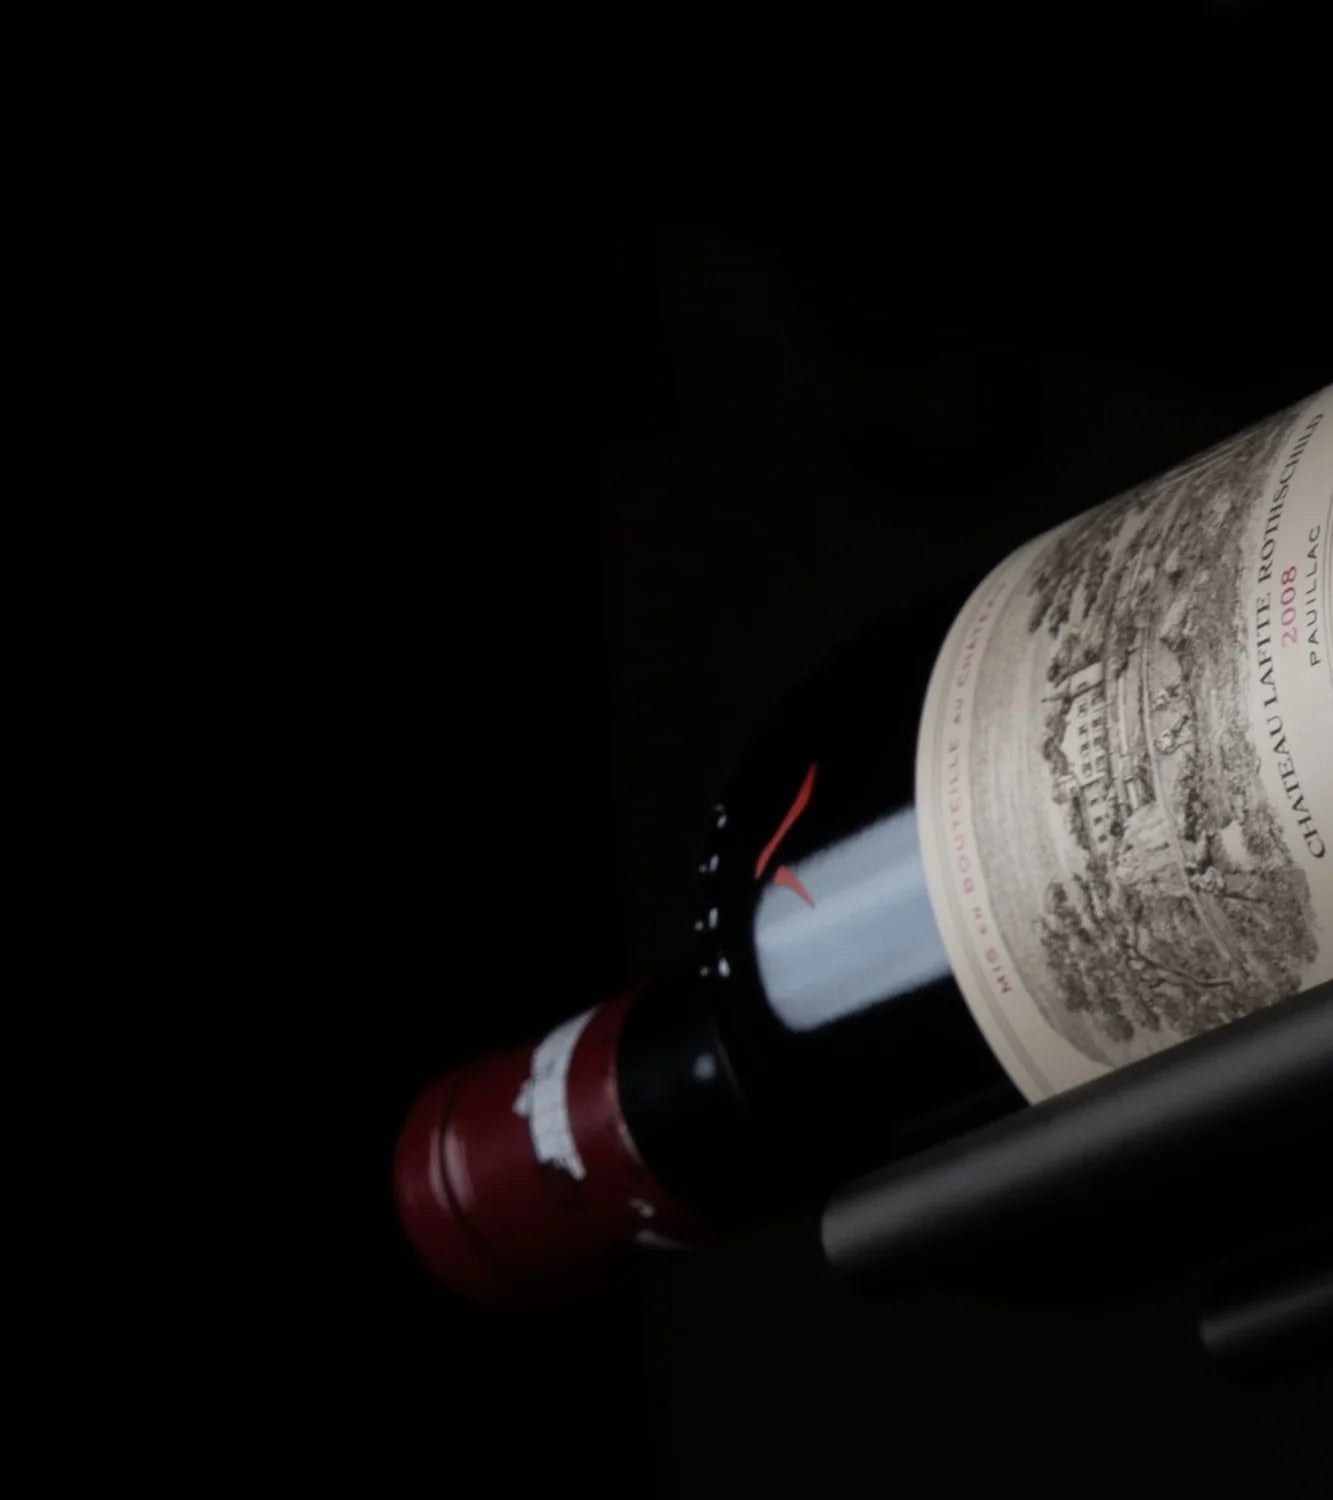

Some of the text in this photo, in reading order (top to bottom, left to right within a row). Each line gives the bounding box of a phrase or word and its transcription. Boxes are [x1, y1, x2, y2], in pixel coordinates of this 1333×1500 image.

[1255, 412, 1327, 860] CHATEAU LAFITE ROTHSCHILD
[1280, 564, 1298, 649] 2008
[1307, 523, 1323, 668] PAUILLAC
